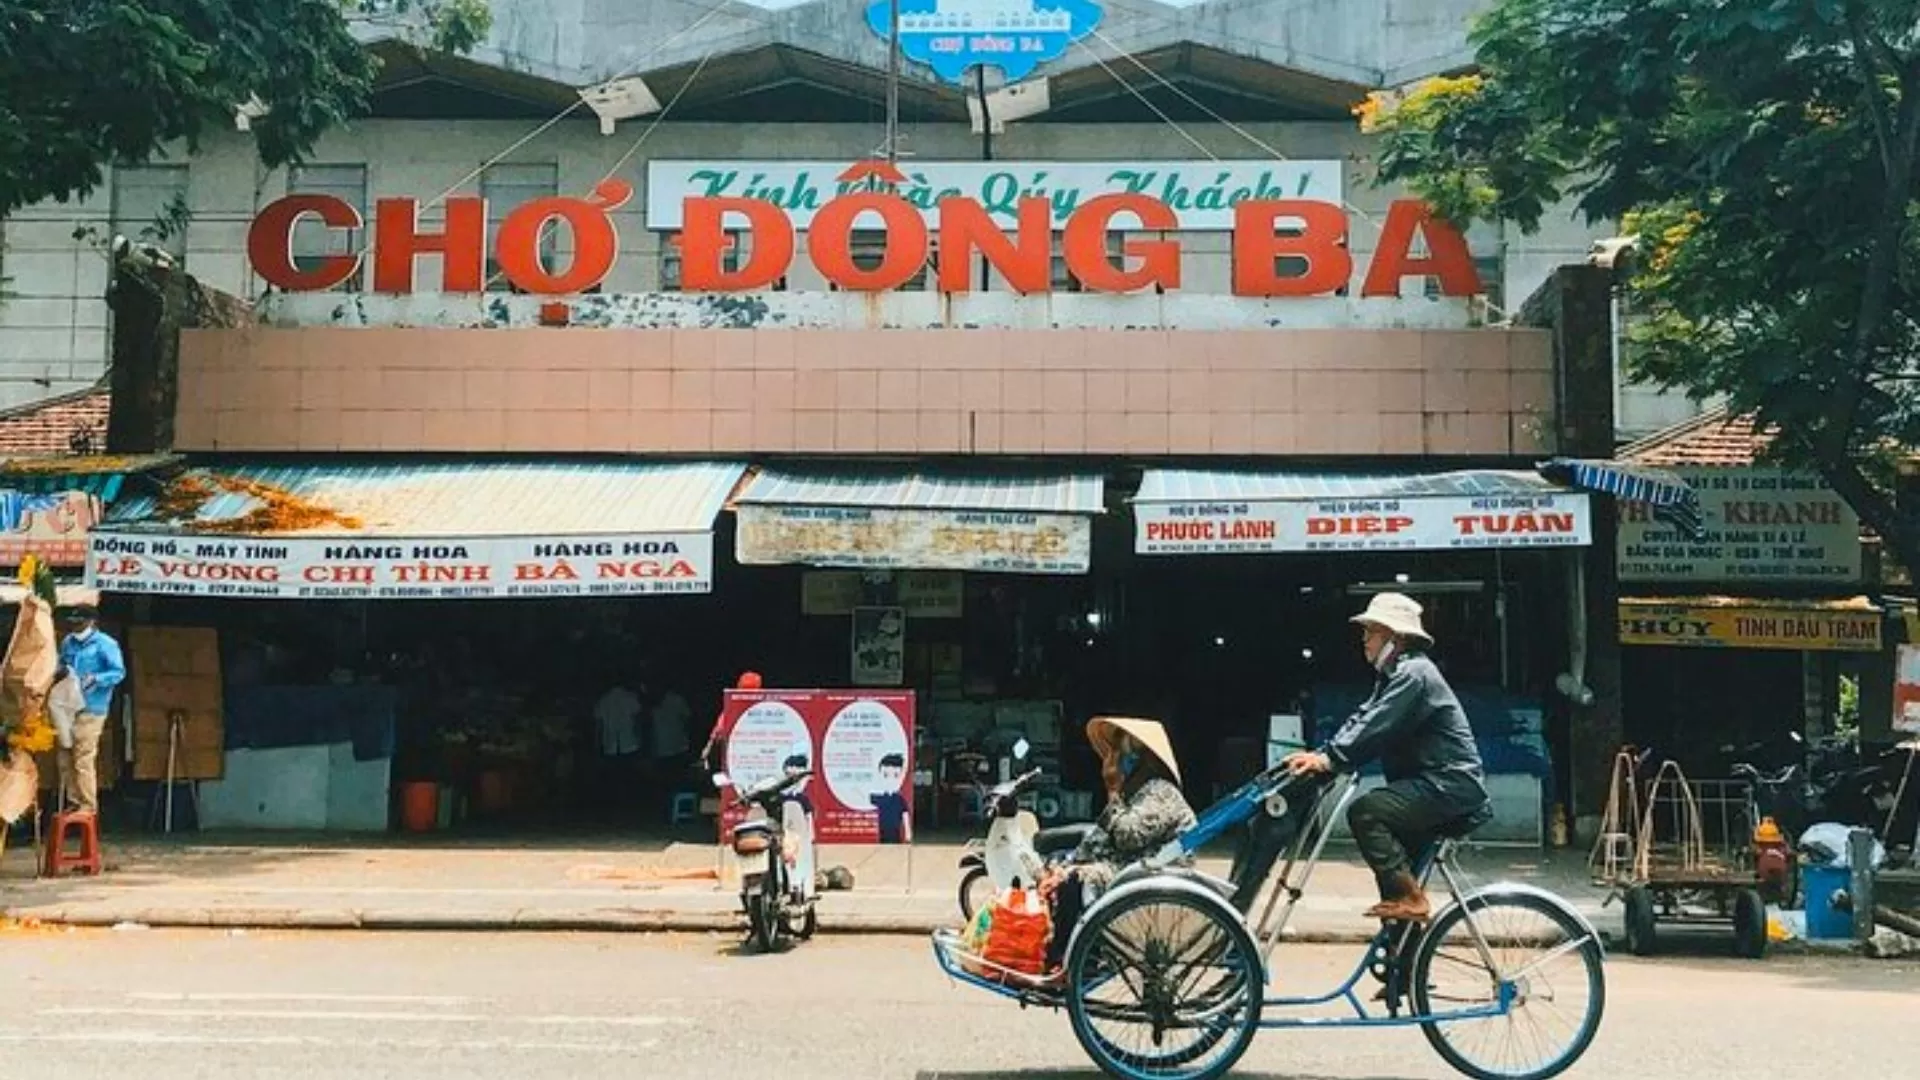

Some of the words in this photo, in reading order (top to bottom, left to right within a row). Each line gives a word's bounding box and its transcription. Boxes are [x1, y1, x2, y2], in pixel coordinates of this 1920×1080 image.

[247, 179, 634, 325] CHỢ
[670, 161, 1181, 294] ĐÔNG
[1232, 196, 1483, 297] BA
[195, 543, 238, 559] MÁY
[303, 565, 376, 585] CHỊ
[391, 561, 491, 582] TÌNH
[514, 558, 578, 580] BÀ
[597, 560, 697, 578] NGA
